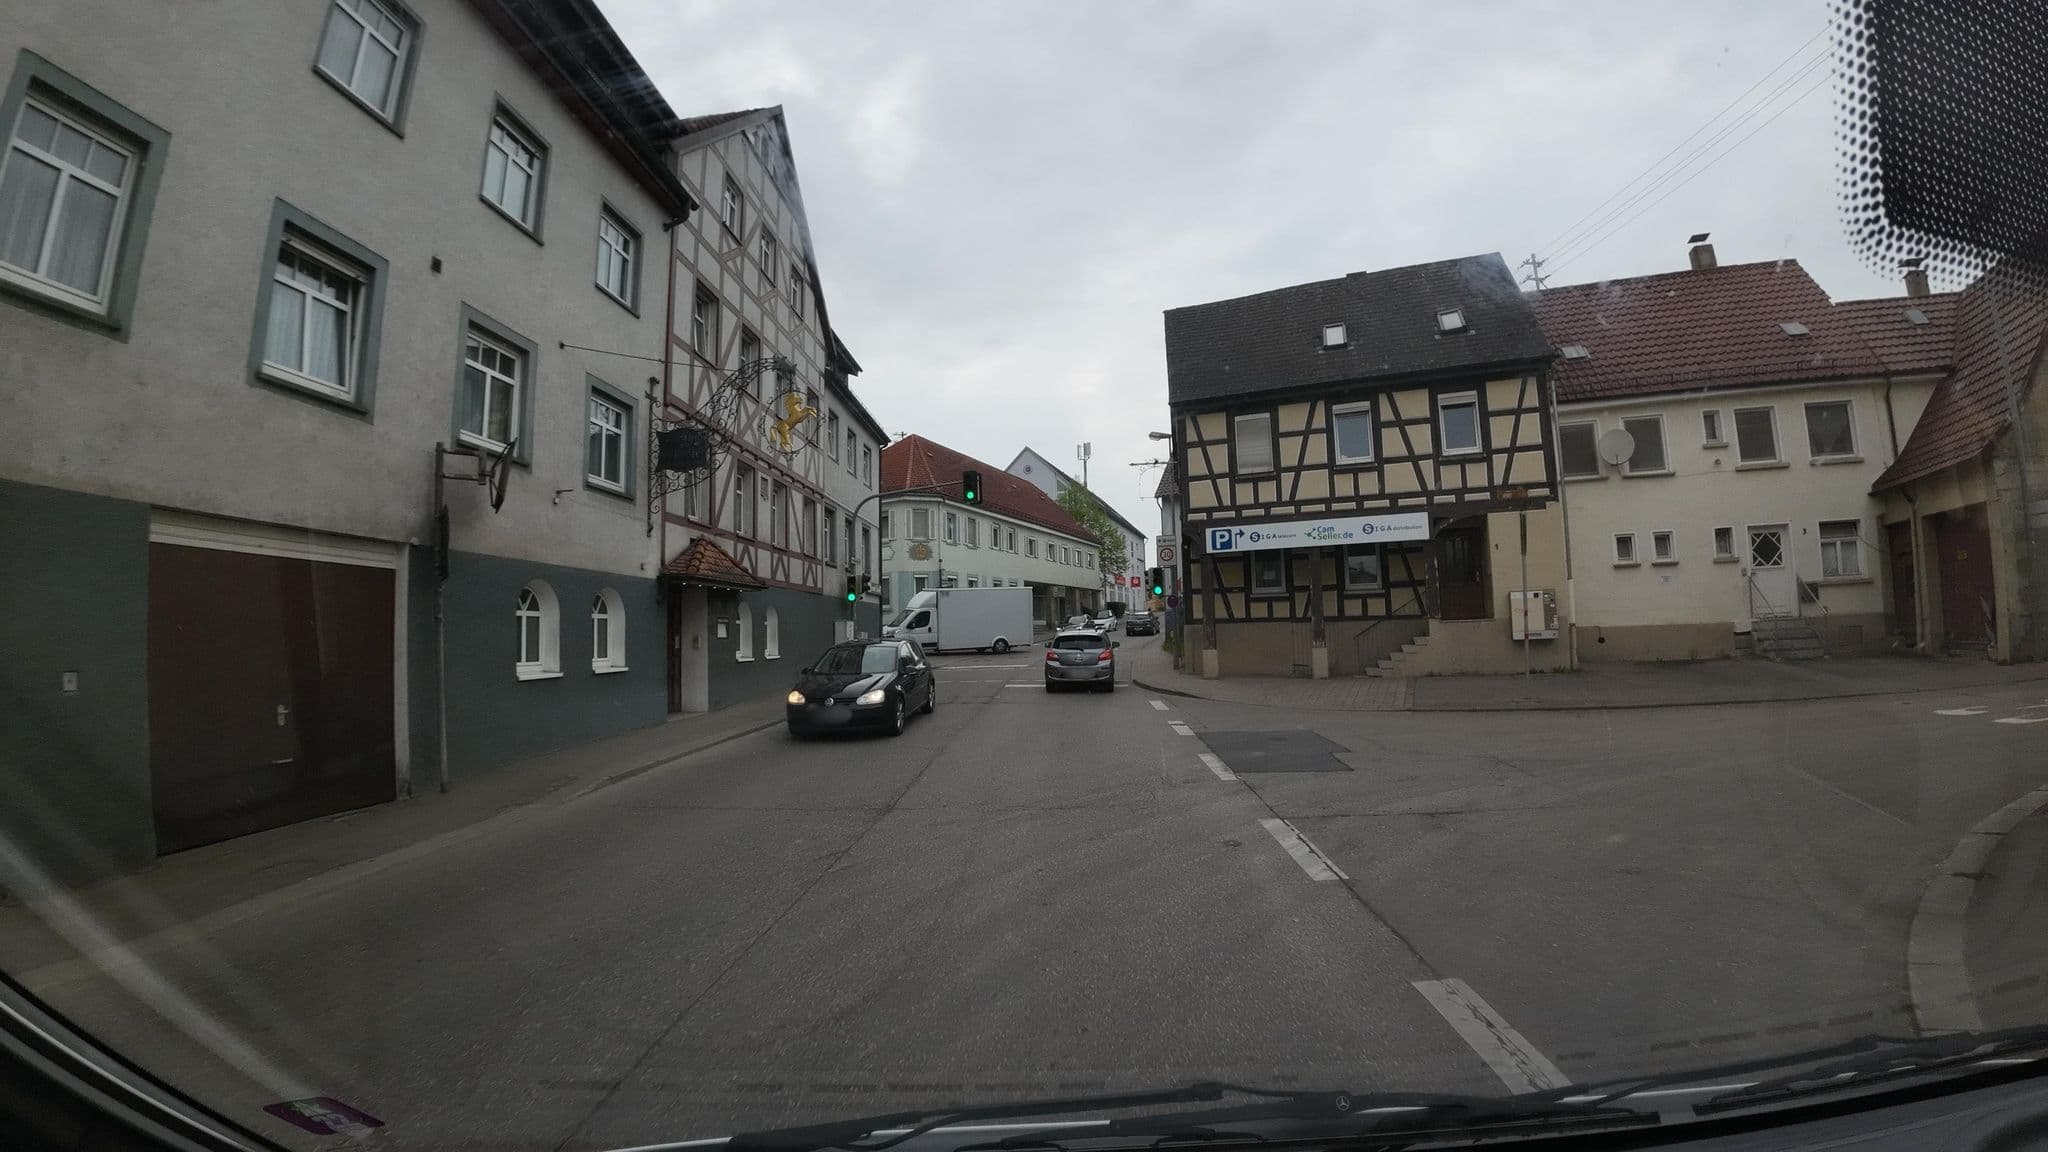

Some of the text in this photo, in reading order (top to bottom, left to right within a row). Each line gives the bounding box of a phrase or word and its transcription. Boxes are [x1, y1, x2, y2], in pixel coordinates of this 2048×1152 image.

[1317, 525, 1335, 533] Cam
[1215, 530, 1230, 549] P
[1317, 531, 1354, 541] Seller.de
